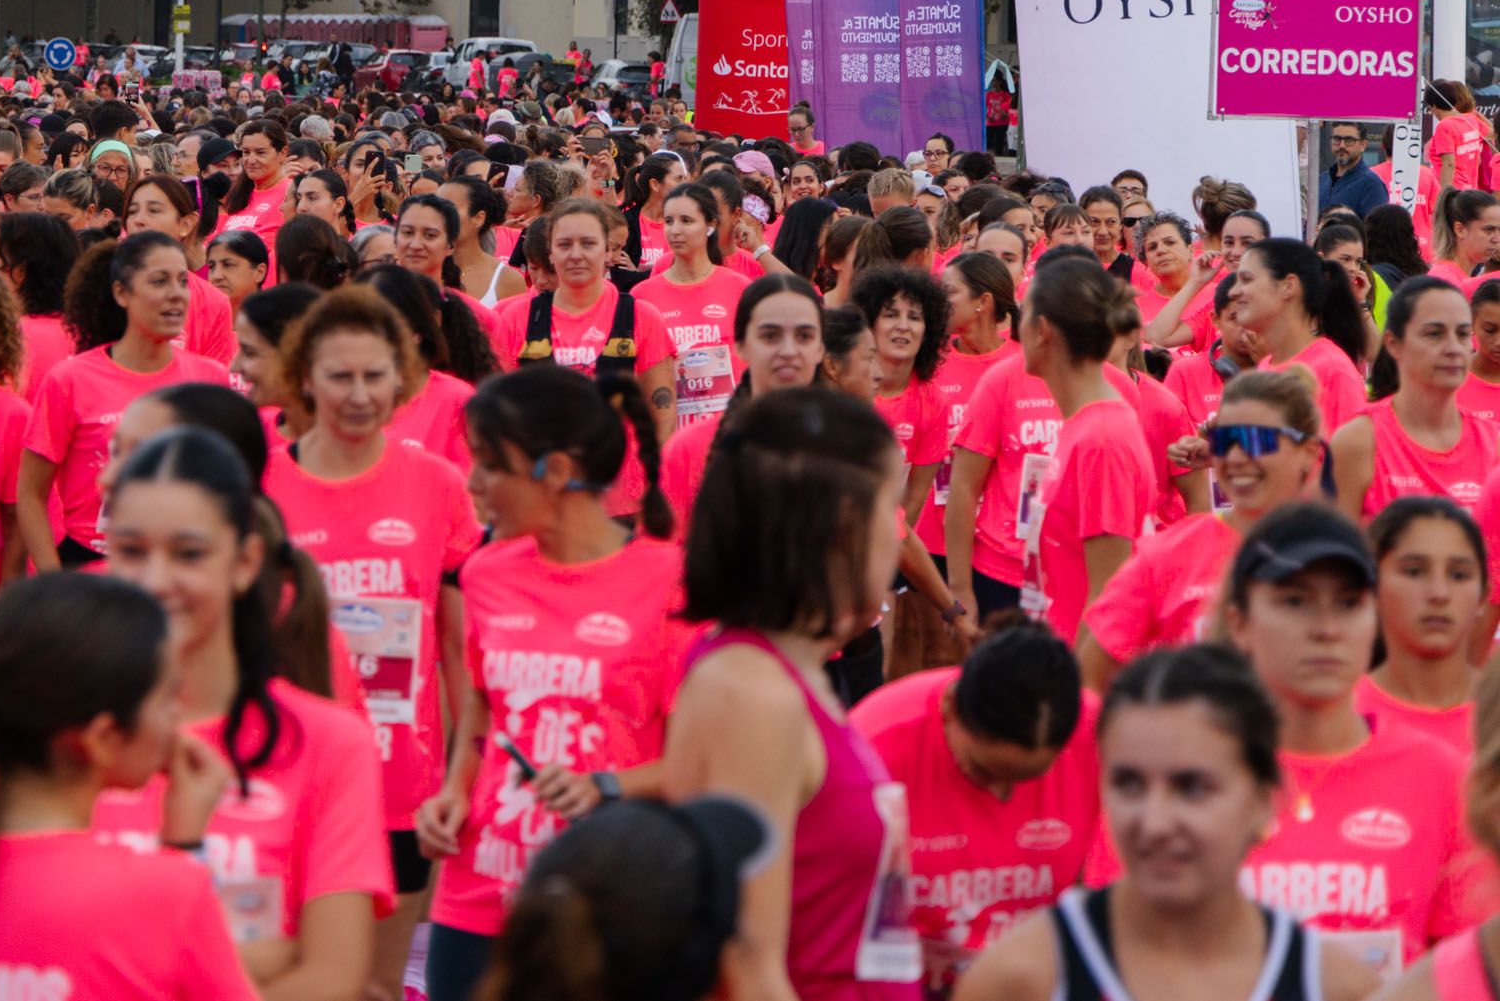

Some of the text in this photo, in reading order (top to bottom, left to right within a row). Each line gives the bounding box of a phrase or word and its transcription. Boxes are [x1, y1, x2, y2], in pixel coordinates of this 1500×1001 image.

[1335, 6, 1413, 24] OYSHO
[1220, 47, 1414, 78] CORREDORAS
[687, 377, 714, 390] 016
